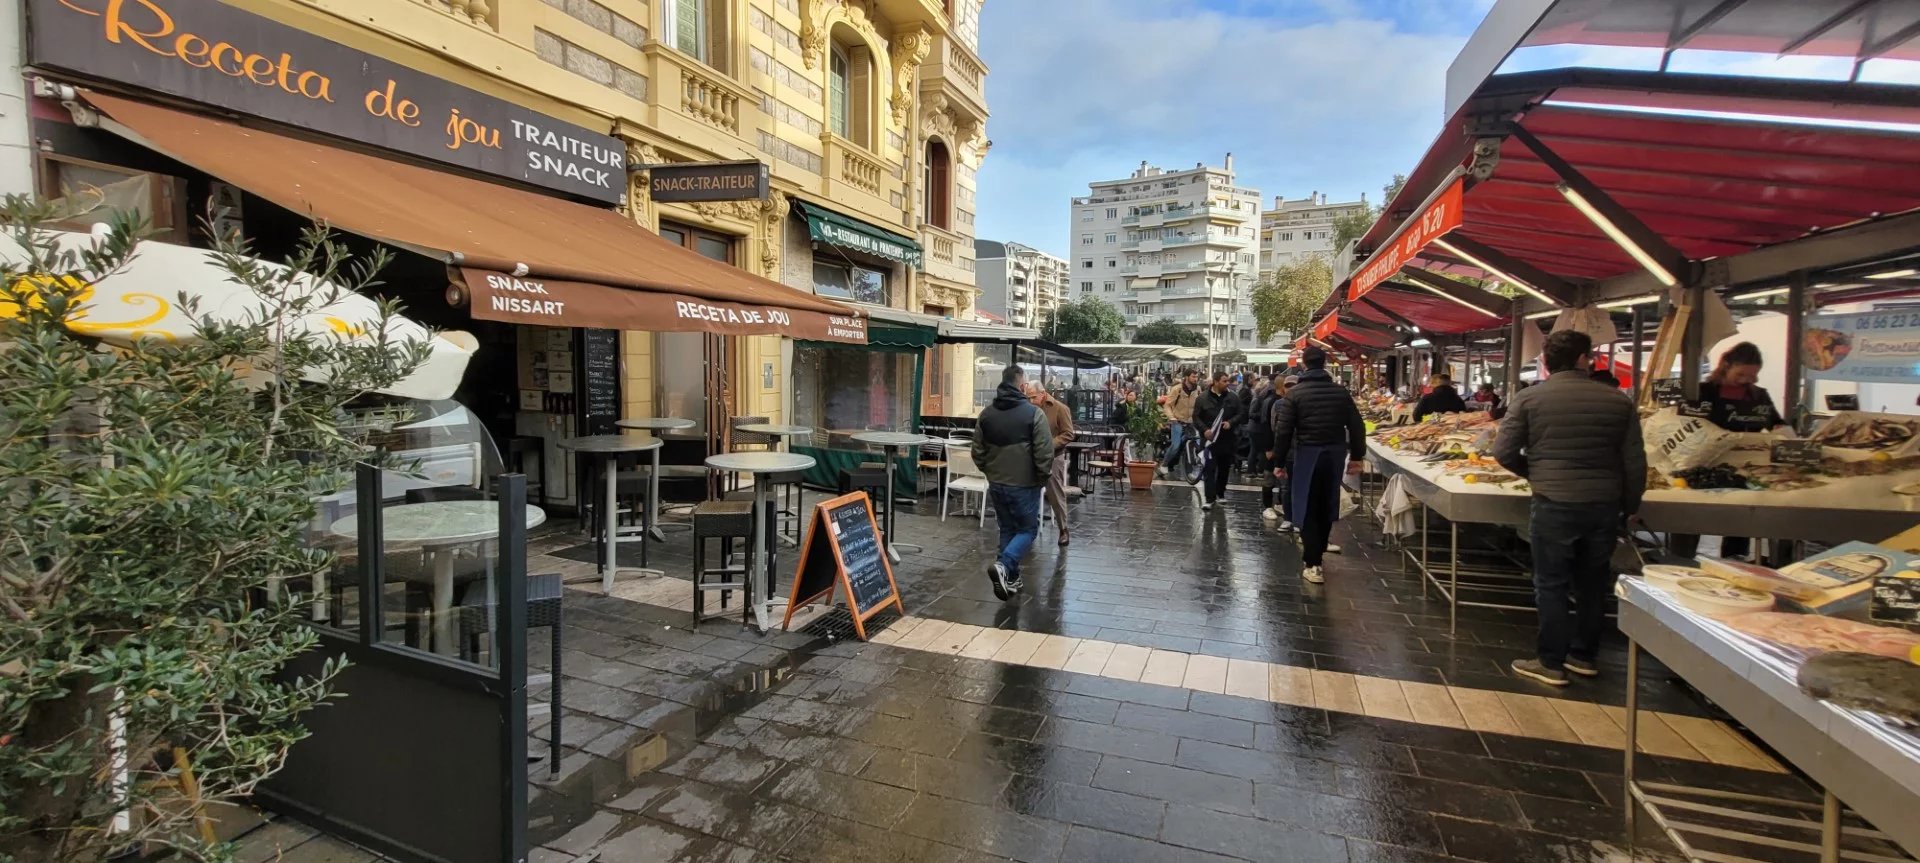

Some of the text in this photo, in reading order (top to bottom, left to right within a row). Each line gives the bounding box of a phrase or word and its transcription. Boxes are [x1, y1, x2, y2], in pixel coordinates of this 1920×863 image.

[104, 0, 502, 149] Receta de jou
[511, 119, 622, 169] TRAITEUR
[528, 151, 611, 189] SNACK
[653, 174, 755, 192] SNACK-TRAITEUR
[880, 241, 904, 259] PRINTEMPS
[486, 275, 549, 295] SNACK
[491, 296, 564, 316] NISSART
[675, 301, 790, 326] RECETA DE JOU
[829, 316, 863, 329] SUR PLACE
[1856, 318, 1870, 329] 06
[1890, 315, 1907, 328] 23
[834, 328, 864, 339] EMPORTER
